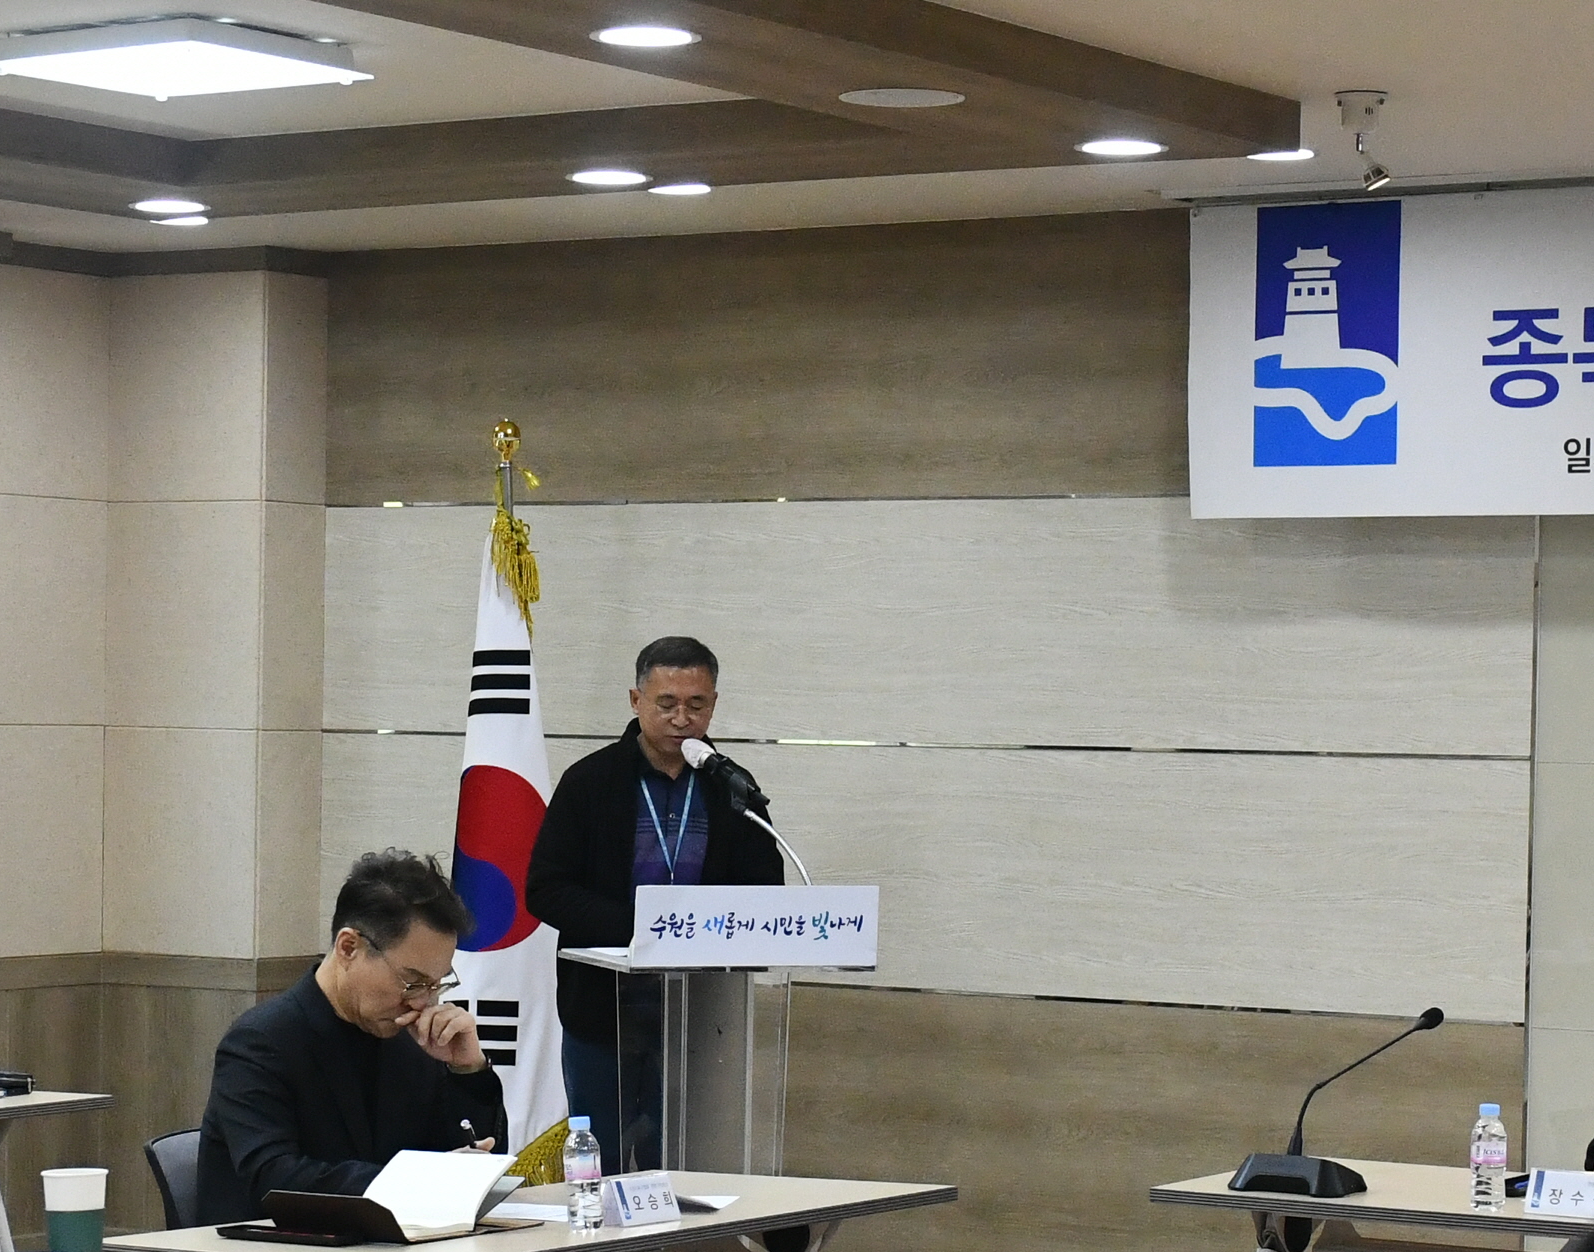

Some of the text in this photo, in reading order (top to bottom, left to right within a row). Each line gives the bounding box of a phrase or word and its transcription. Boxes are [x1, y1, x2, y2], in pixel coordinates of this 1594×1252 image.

[649, 910, 865, 941] 수원을 새롭게 시민을 빛나게
